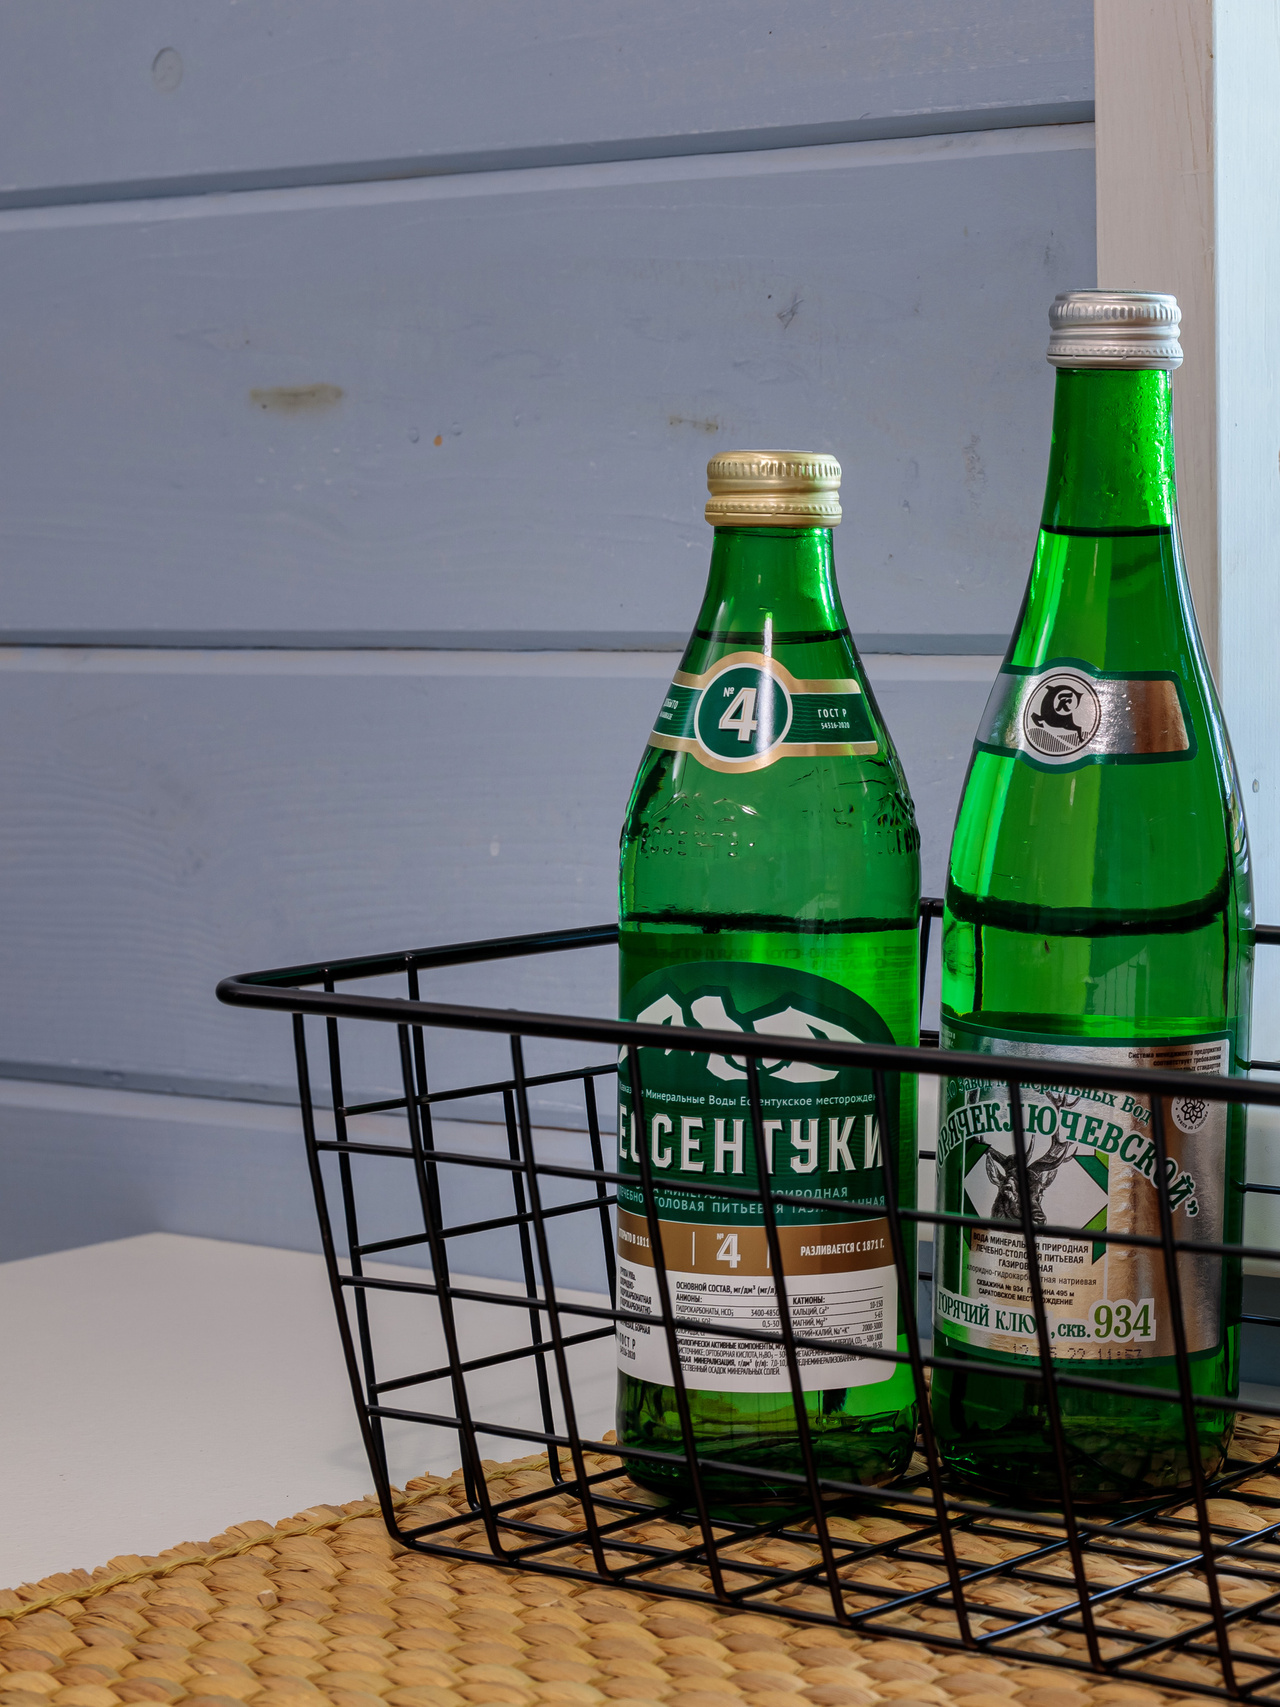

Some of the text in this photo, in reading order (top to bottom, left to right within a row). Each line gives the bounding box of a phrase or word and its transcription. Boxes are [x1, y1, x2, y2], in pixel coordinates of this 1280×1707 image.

[817, 709, 848, 718] ГОСТ Р
[646, 1088, 706, 1105] Минеральные
[708, 1095, 737, 1107] Воды
[740, 1096, 813, 1109] Есентукское
[712, 1202, 784, 1214] ПИТЬЕВЯ
[800, 1242, 855, 1257] РАЗЛИВАЕТСЯ
[862, 1239, 880, 1252] 1871
[973, 1232, 1089, 1254] ВОДА МИНЕРАЛЬЯ ПРИРОДНАЯ
[975, 1244, 1084, 1264] ЛЕЧЕБНО-СТОЛОЯ ПИТЬЕВАЯ
[998, 1258, 1054, 1273] ГАЗИРОВНАЯ
[676, 1280, 708, 1292] ОСНОВНОЙ
[708, 1284, 733, 1295] СОСТАВ,
[976, 1278, 1004, 1292] СКВАЖИНА
[1013, 1285, 1024, 1293] 934
[1026, 1287, 1055, 1297] ГИНА
[1056, 1291, 1069, 1299] 495
[1058, 1277, 1098, 1287] натриевая
[675, 1293, 703, 1304] АНИОНЫ:
[792, 1296, 826, 1306] КАТИОНЫ:
[978, 1287, 1074, 1306] САРАТОВСКОЕ МЕСТОЖДЕНИЕ
[676, 1304, 720, 1318] ГИДРОКАРБОНАТЫ,
[751, 1309, 780, 1317] 3400-4850
[792, 1306, 818, 1317] КАЛЬЦИЙ,
[937, 1290, 1152, 1340] ГОРЯЧИЙ КЛЮ, скв. 934
[762, 1319, 780, 1329] 0,5-30
[792, 1317, 815, 1328] МАГНИЙ,
[711, 1340, 737, 1350] АКТИВНЫЕ
[680, 1354, 692, 1363] БЩАЯ
[693, 1356, 735, 1367] МИНЕРАЛИЗАЦИЯ,
[770, 1359, 788, 1368] 7,0-10,
[708, 1365, 727, 1374] ОСАДОК
[727, 1366, 763, 1376] МИНЕРАЛЬНЫХ
